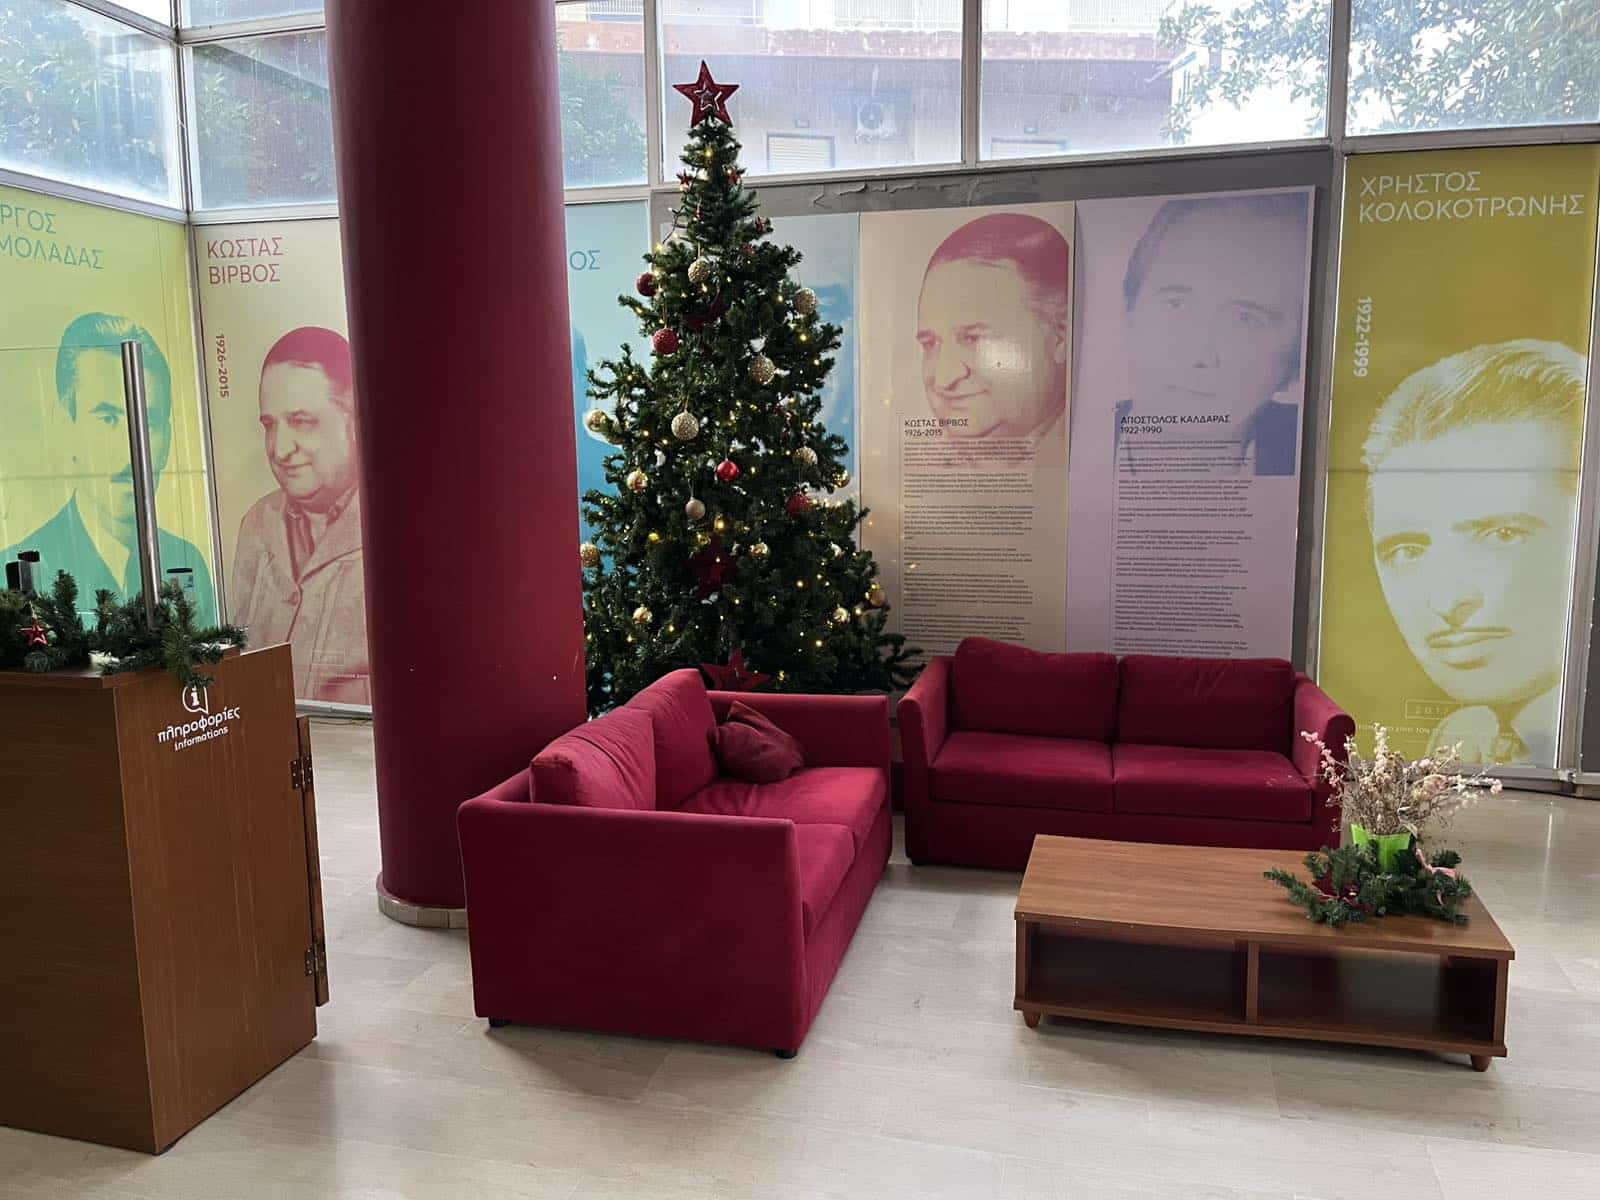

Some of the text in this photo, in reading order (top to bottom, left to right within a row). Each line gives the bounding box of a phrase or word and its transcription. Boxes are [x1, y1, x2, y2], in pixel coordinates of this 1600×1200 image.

[1360, 171, 1481, 197] ΧΡΗΣΤΟΣ
[1359, 194, 1585, 224] ΚΟΛΟΚΟΤΡΩΝΗΣ
[207, 237, 284, 259] ΚΩΣΤΑΣ
[208, 263, 281, 285] ΒΙΡΒΟΣ
[1353, 296, 1373, 378] 1922-1999
[215, 334, 230, 398] 1926-2015
[904, 418, 969, 428] ΚΩΣΤΑΣ ΒΙΡΒΟΣ
[1120, 414, 1231, 425] ΑΠΟΣΤΟΛΟΣ ΚΑΛΔΑΡΑΣ
[1120, 425, 1162, 434] 1922-1990
[157, 706, 241, 743] πληροφορίες
[174, 725, 229, 752] informations
